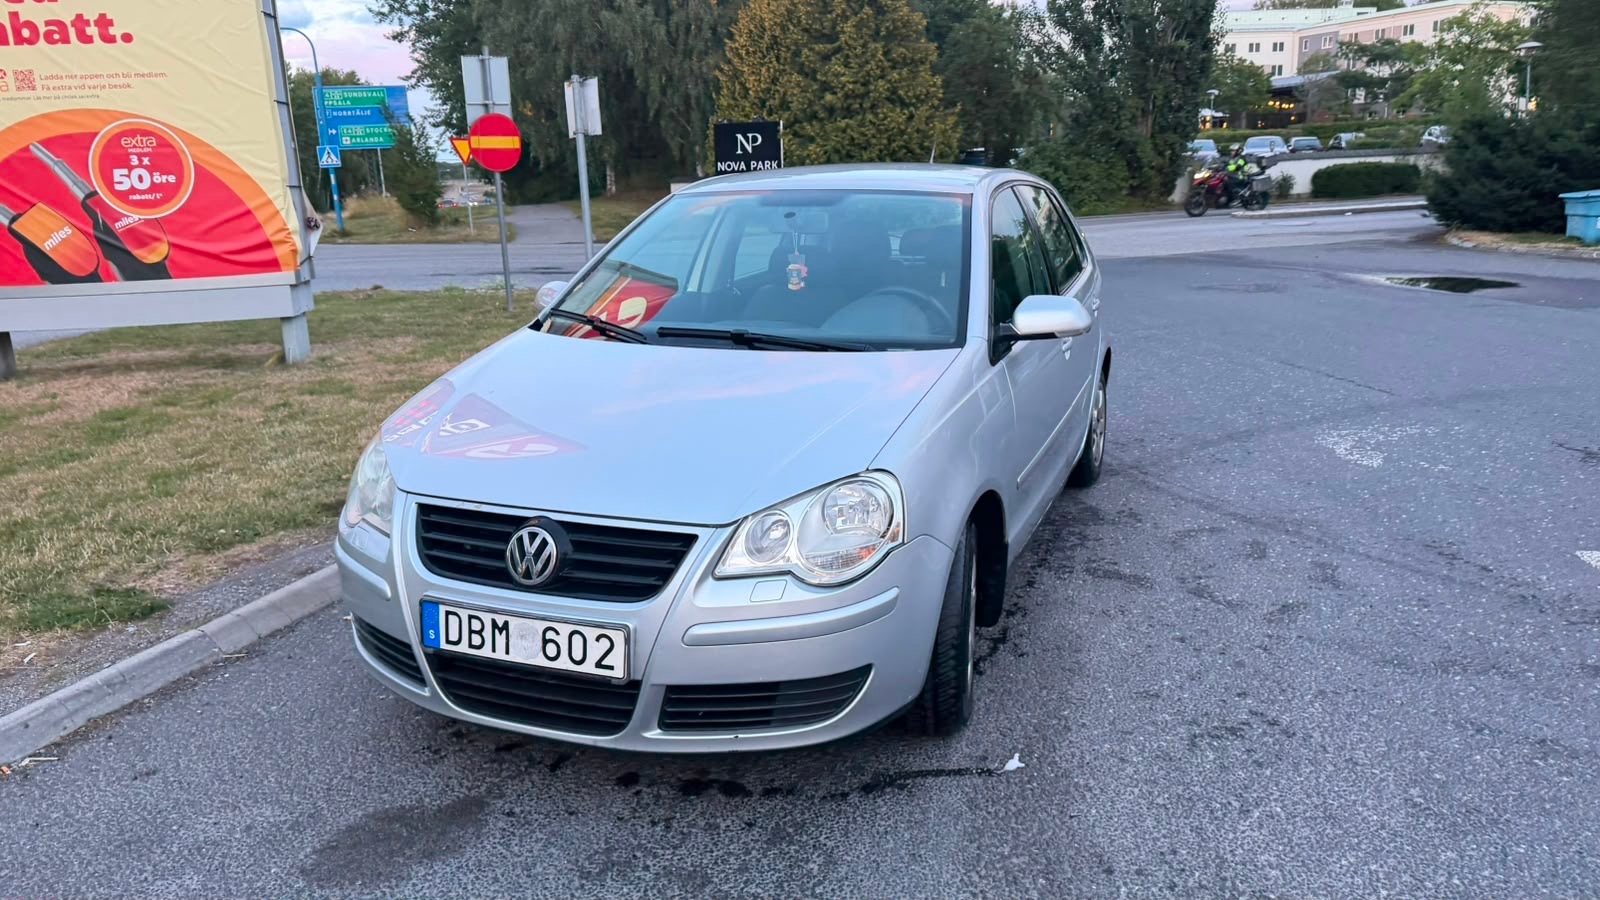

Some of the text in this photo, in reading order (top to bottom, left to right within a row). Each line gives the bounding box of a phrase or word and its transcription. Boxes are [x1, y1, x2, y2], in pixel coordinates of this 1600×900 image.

[41, 83, 51, 91] Få
[87, 83, 106, 91] varje
[121, 134, 157, 148] extra
[735, 132, 763, 154] NP
[129, 154, 151, 166] 3 x
[717, 160, 779, 172] NOVA PARK
[112, 167, 176, 191] 50 öre
[43, 225, 73, 251] miles
[507, 527, 556, 585] VW
[428, 629, 435, 639] S
[444, 609, 615, 671] DBM 602
